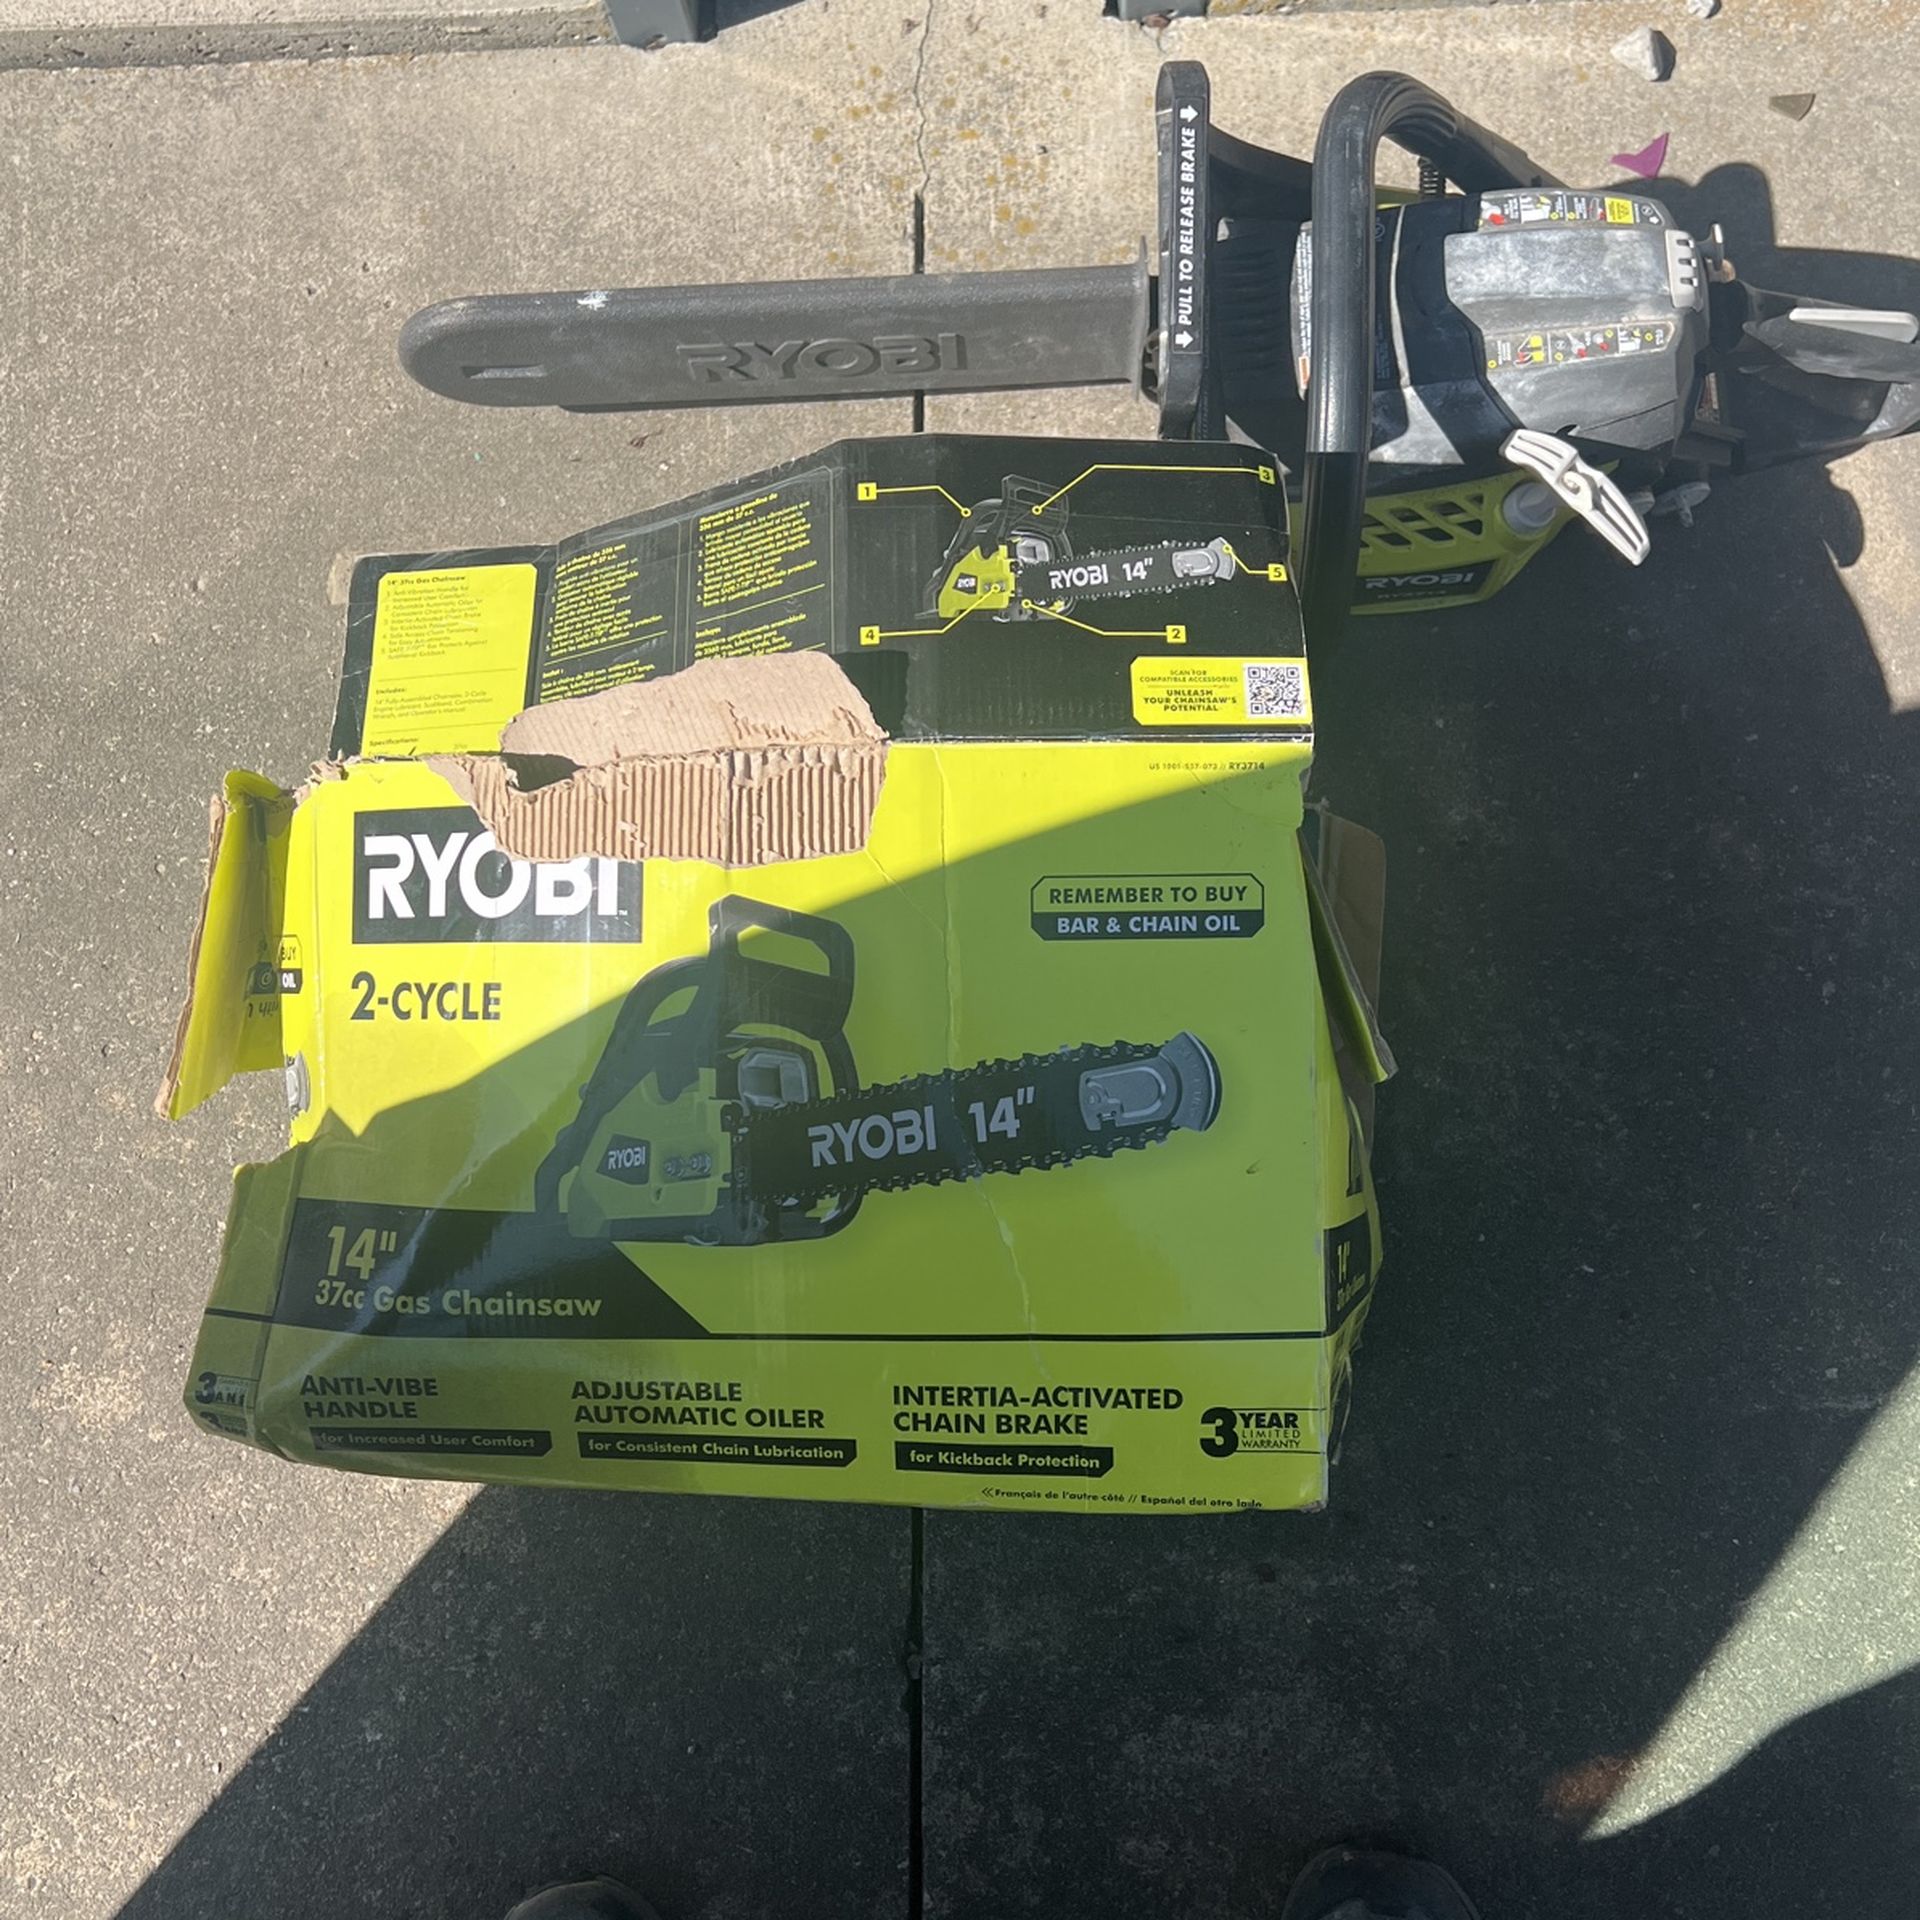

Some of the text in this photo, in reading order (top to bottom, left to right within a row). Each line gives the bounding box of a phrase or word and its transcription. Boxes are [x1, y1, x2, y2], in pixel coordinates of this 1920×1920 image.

[1178, 127, 1196, 325] PULL TO RELEASE BRAKE
[677, 332, 967, 382] RYOBI
[1049, 557, 1153, 589] RYOBI 14"
[1365, 572, 1474, 589] RYOBI
[865, 630, 875, 640] 4
[1163, 704, 1219, 712] POTENTIAL
[363, 831, 619, 919] RYOBI
[1049, 886, 1248, 904] REMEMBER TO BUY
[1057, 915, 1240, 933] BAR & CHAIN OIL
[282, 972, 297, 988] OIL
[350, 970, 502, 1021] 2-CYCLE
[807, 1086, 1036, 1168] RYOBI 14"
[607, 1145, 646, 1171] RYOBI
[326, 1225, 397, 1280] 14"
[314, 1279, 602, 1317] 37cc Gas Chainsaw
[195, 1371, 218, 1404] 3
[300, 1374, 439, 1397] ANTI-VIBE
[571, 1381, 742, 1402] ADJUSTABLE
[892, 1385, 1183, 1410] INTERTIA-ACTIVATED
[303, 1401, 418, 1419] HANDLE
[574, 1405, 825, 1429] AUTOMATIC OILER
[1239, 1412, 1299, 1429] YEAR
[893, 1411, 1088, 1435] CHAIN BRAKE
[1199, 1407, 1239, 1458] 3
[1241, 1429, 1301, 1439] LIMITED
[319, 1432, 536, 1449] for Increased User Comfort
[588, 1439, 844, 1459] for Consistent Chain Lubrication
[1241, 1440, 1301, 1449] WARRANTY
[909, 1449, 1100, 1470] for Kickback Protection
[994, 1488, 1042, 1501] Français
[1044, 1491, 1059, 1500] de
[1141, 1494, 1186, 1507] Español
